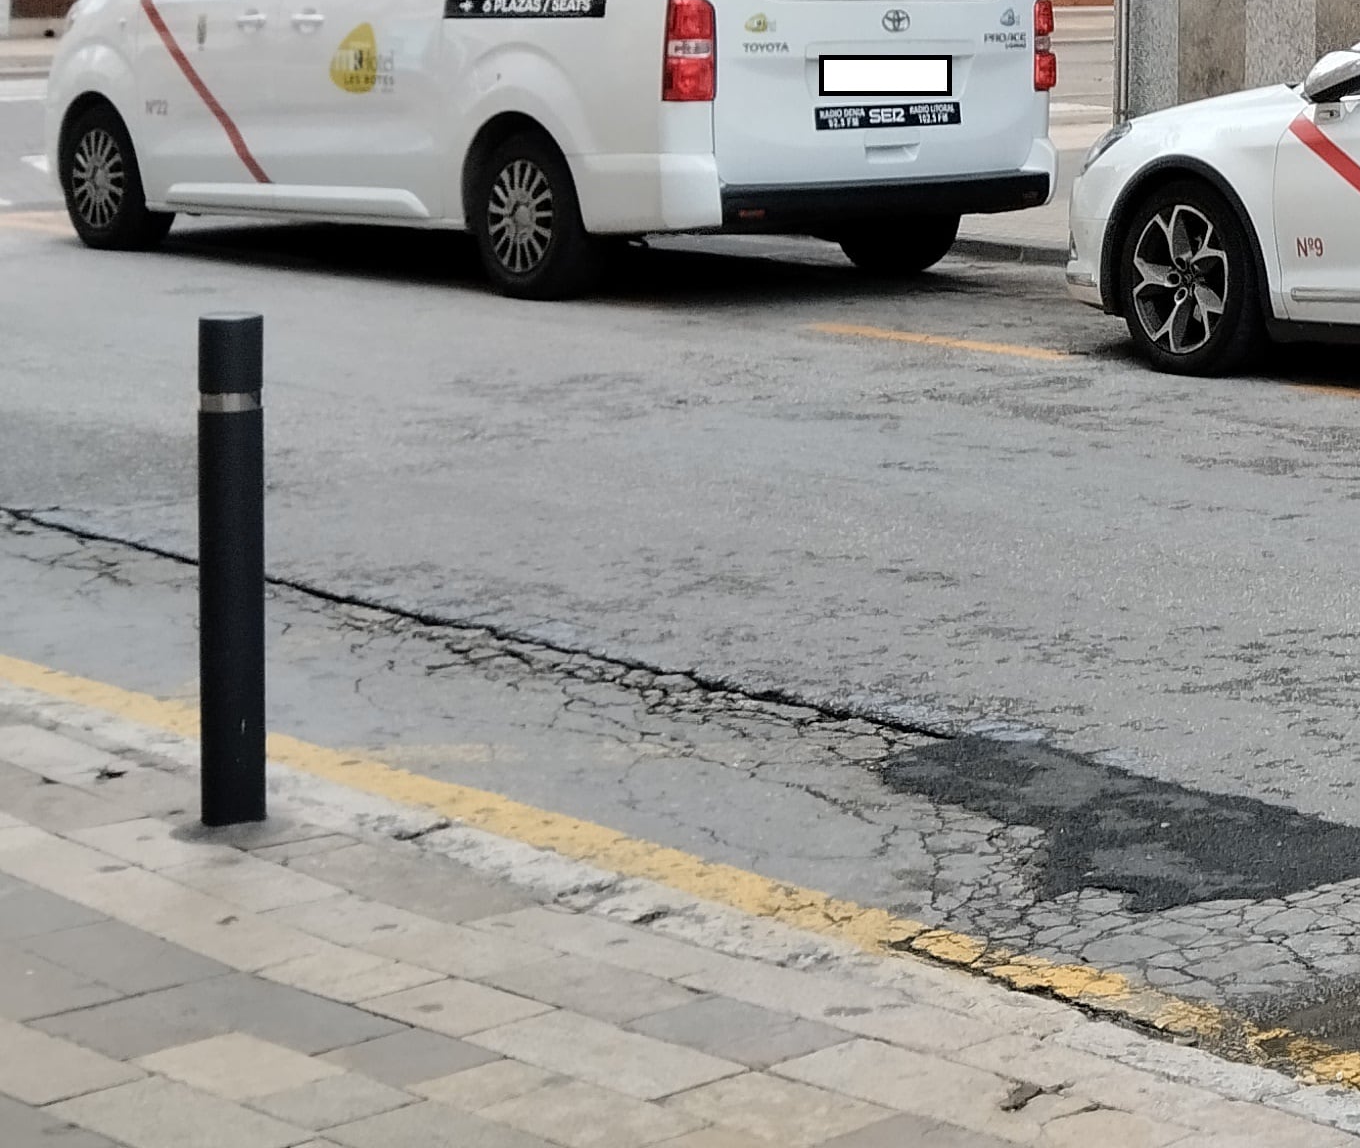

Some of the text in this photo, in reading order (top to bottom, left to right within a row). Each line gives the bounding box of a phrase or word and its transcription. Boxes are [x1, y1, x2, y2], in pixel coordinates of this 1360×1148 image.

[742, 42, 790, 53] TOYOTA
[820, 109, 842, 119] RADIO
[909, 105, 930, 114] RADIO
